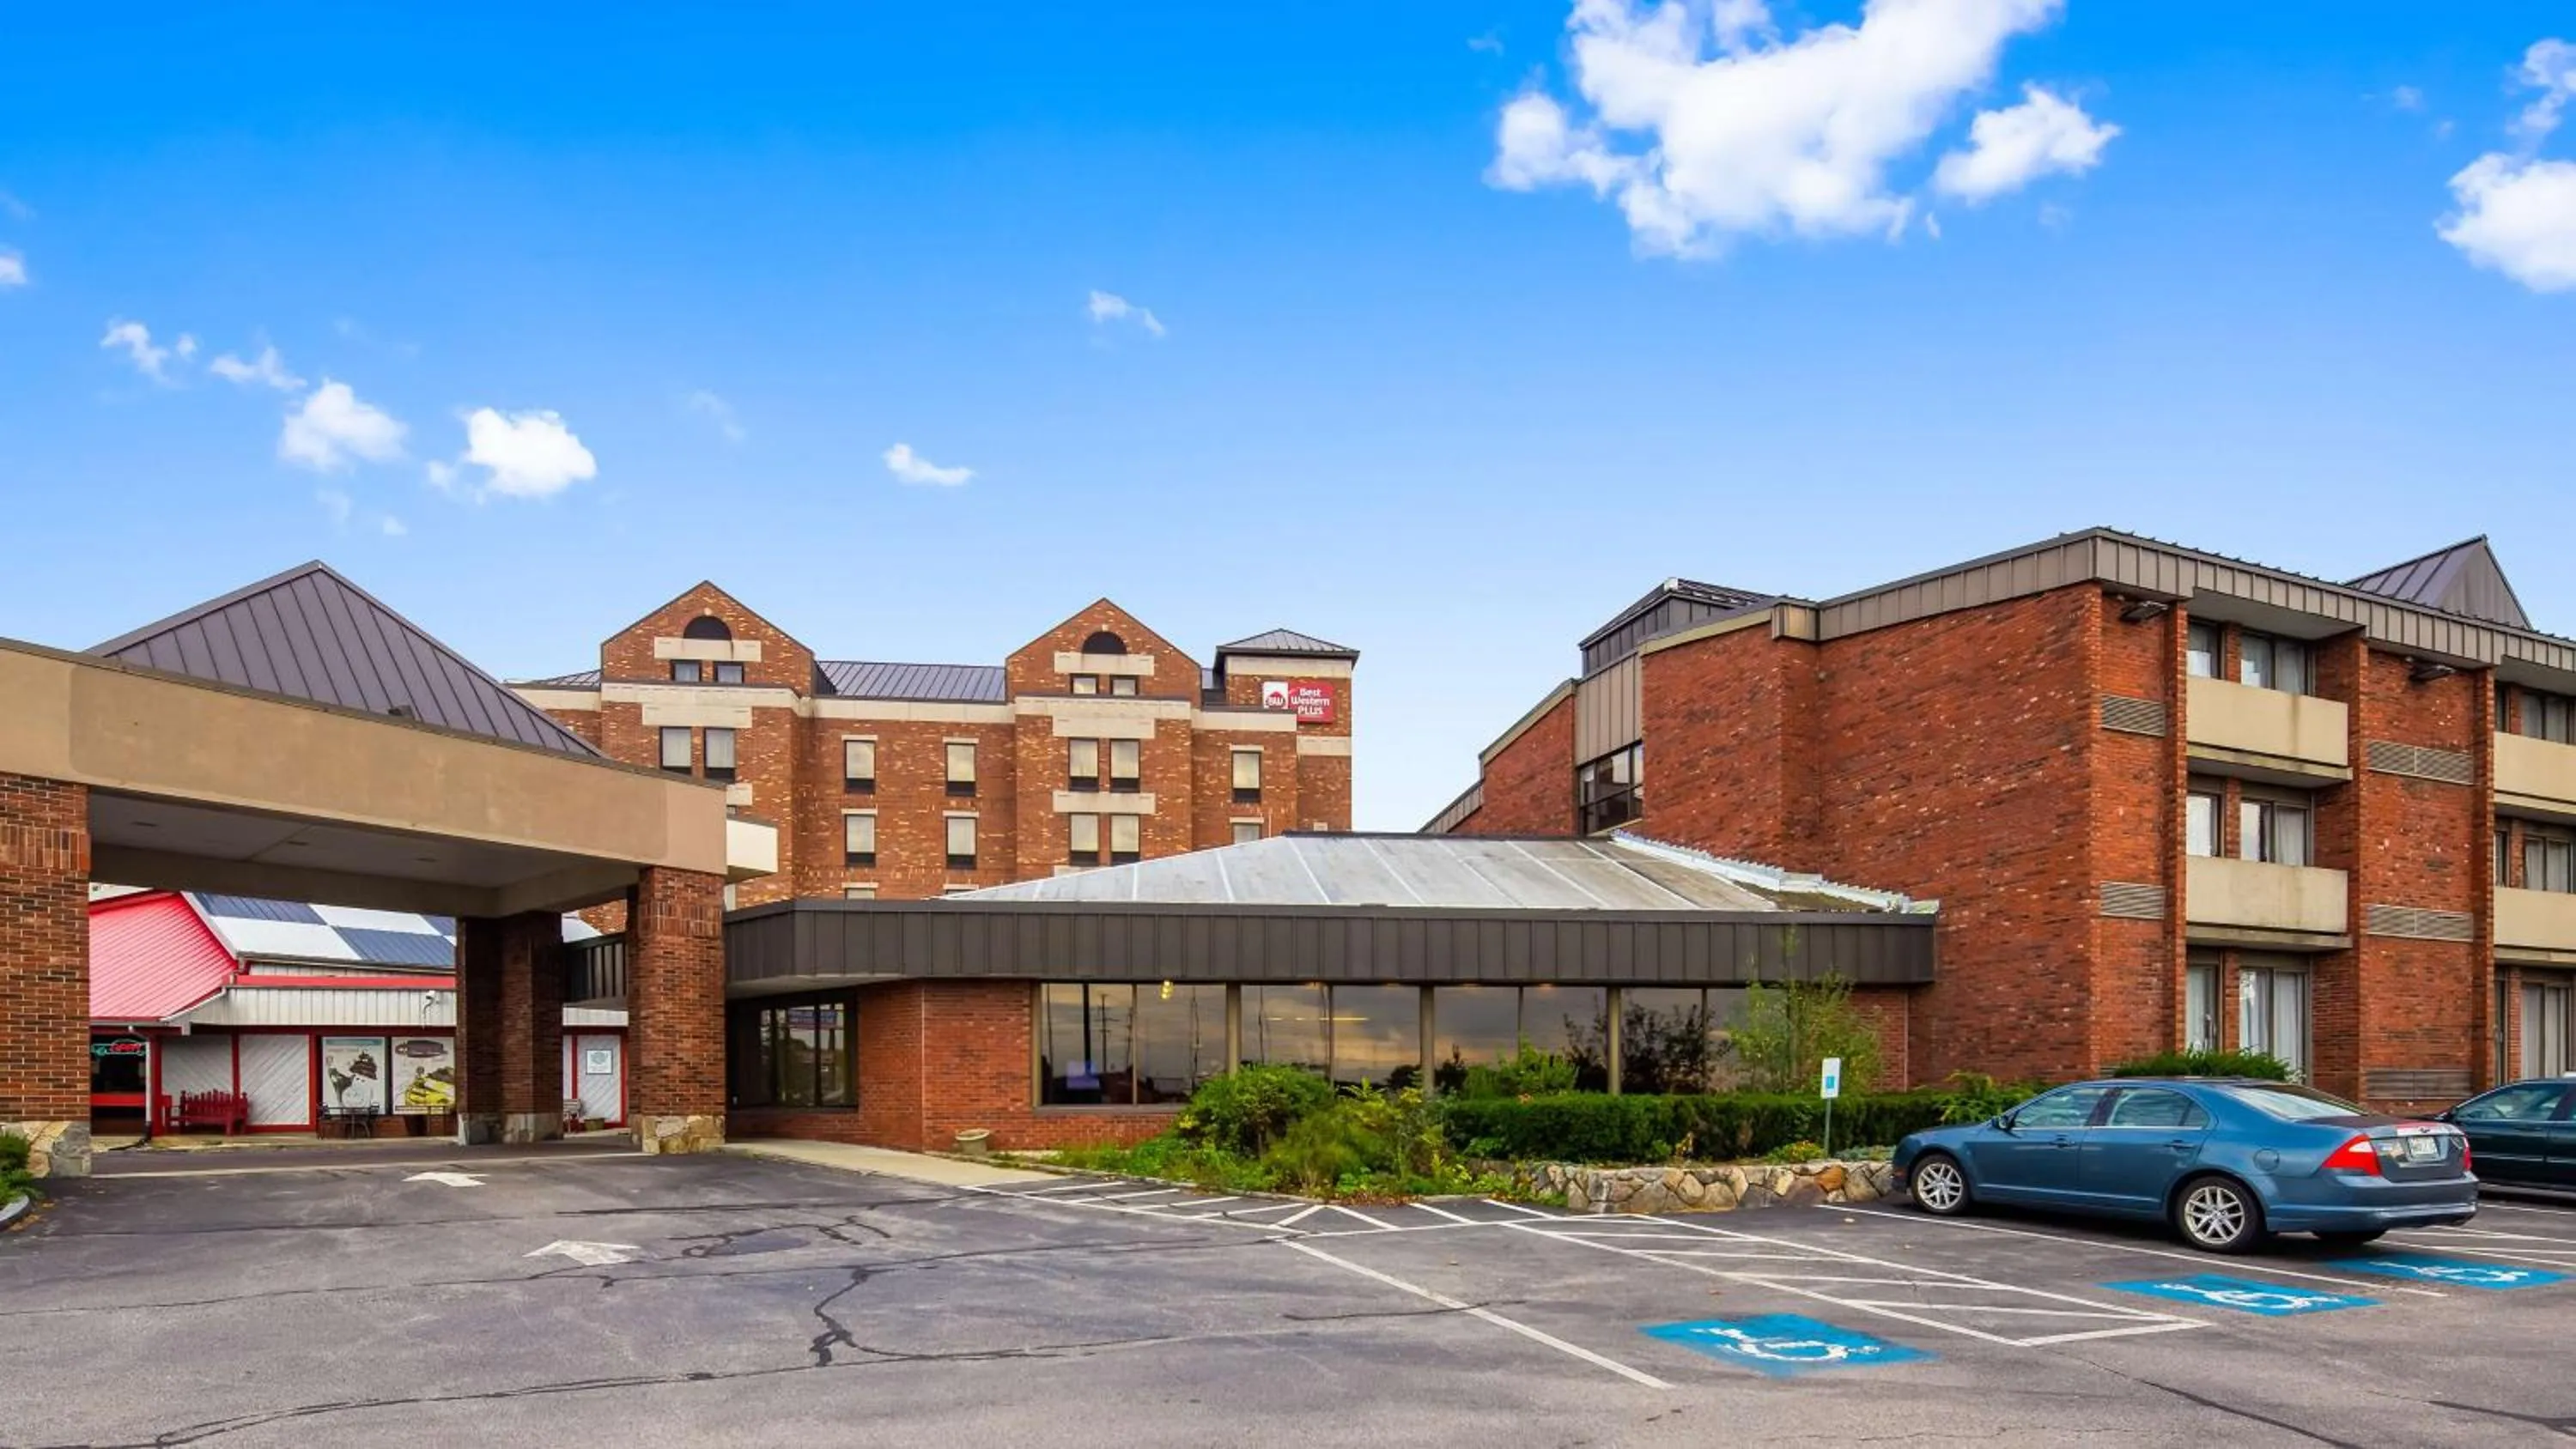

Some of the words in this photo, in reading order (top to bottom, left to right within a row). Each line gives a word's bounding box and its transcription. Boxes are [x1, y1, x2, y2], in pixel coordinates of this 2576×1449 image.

[1300, 688, 1321, 696] Best
[1291, 696, 1330, 706] Western
[1297, 706, 1323, 715] PLUS
